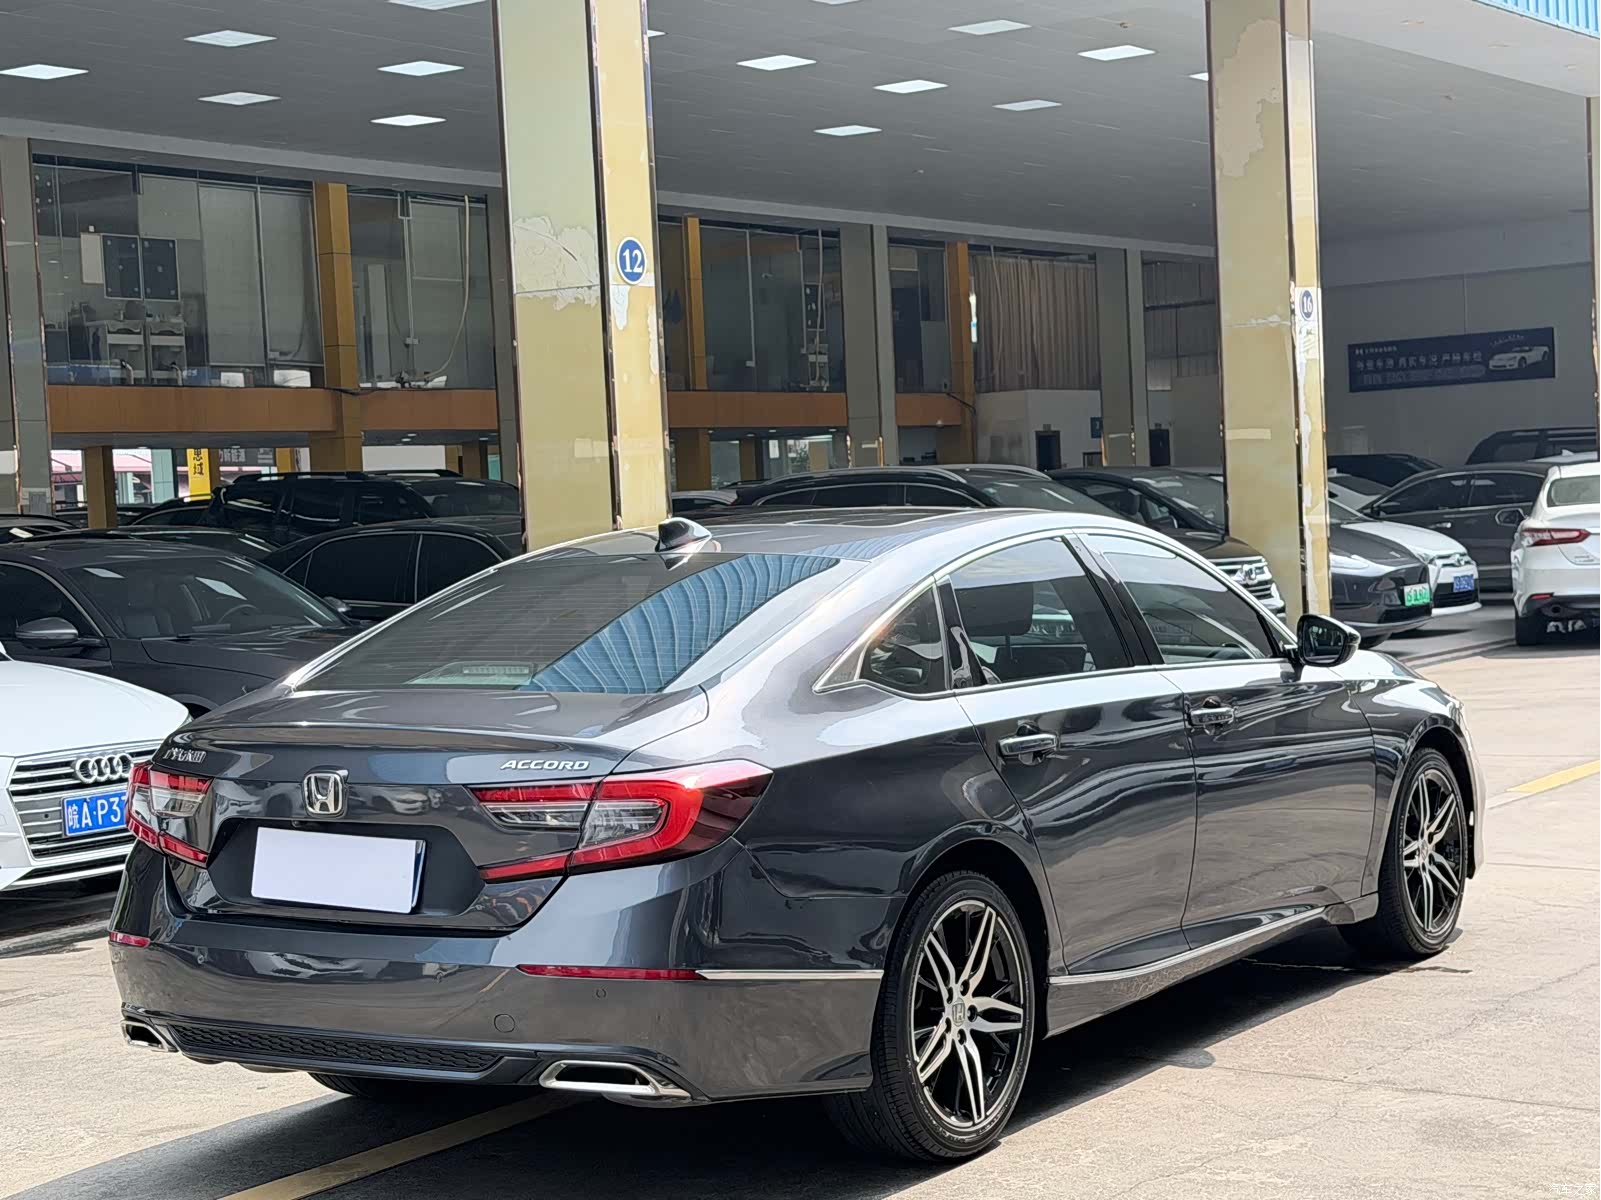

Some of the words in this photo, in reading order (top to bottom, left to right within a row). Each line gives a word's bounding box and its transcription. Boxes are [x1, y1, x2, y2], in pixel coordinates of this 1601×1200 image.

[623, 248, 643, 273] 12
[1303, 295, 1313, 313] 16
[500, 760, 590, 771] ACCORD
